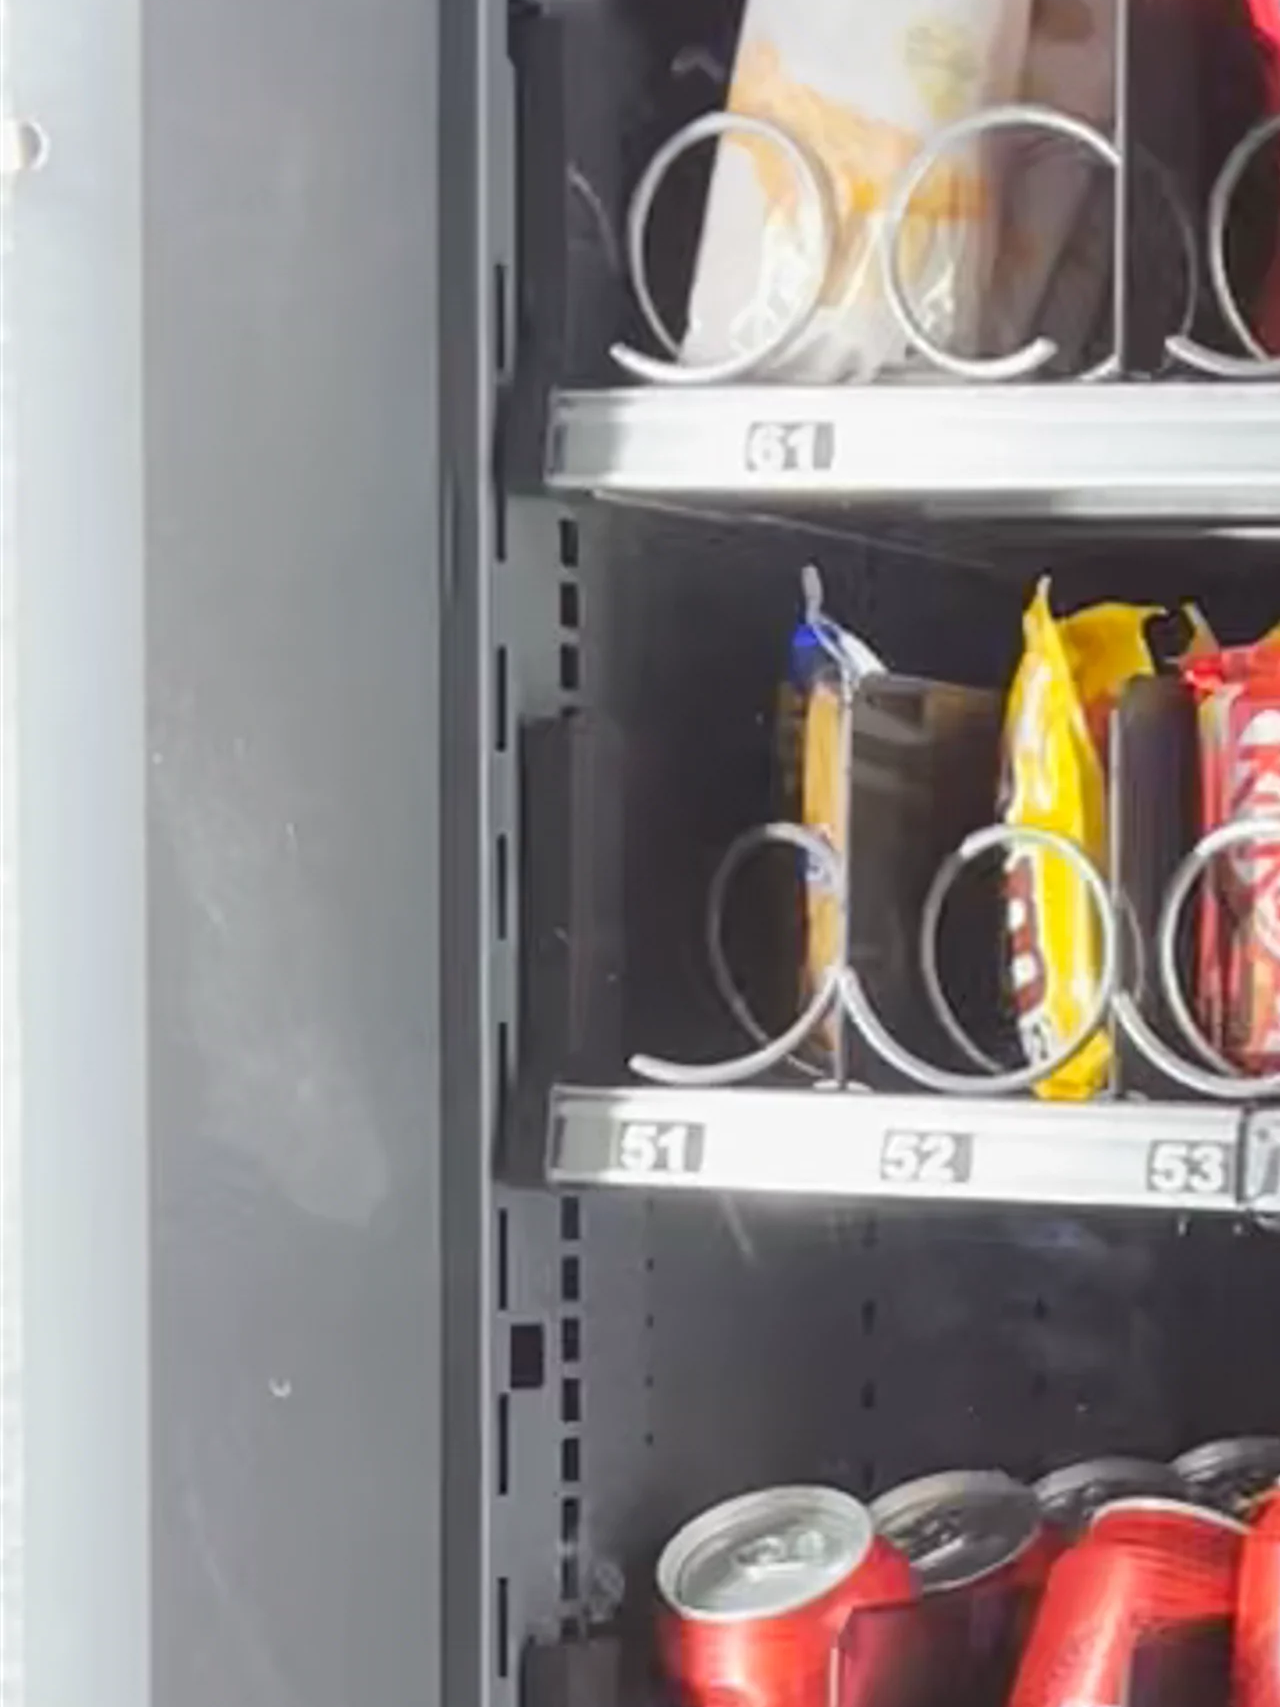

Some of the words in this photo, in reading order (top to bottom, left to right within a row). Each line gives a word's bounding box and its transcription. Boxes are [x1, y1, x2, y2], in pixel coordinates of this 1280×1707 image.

[618, 1125, 690, 1171] 51
[882, 1135, 956, 1181] 52
[1151, 1145, 1226, 1191] 53
